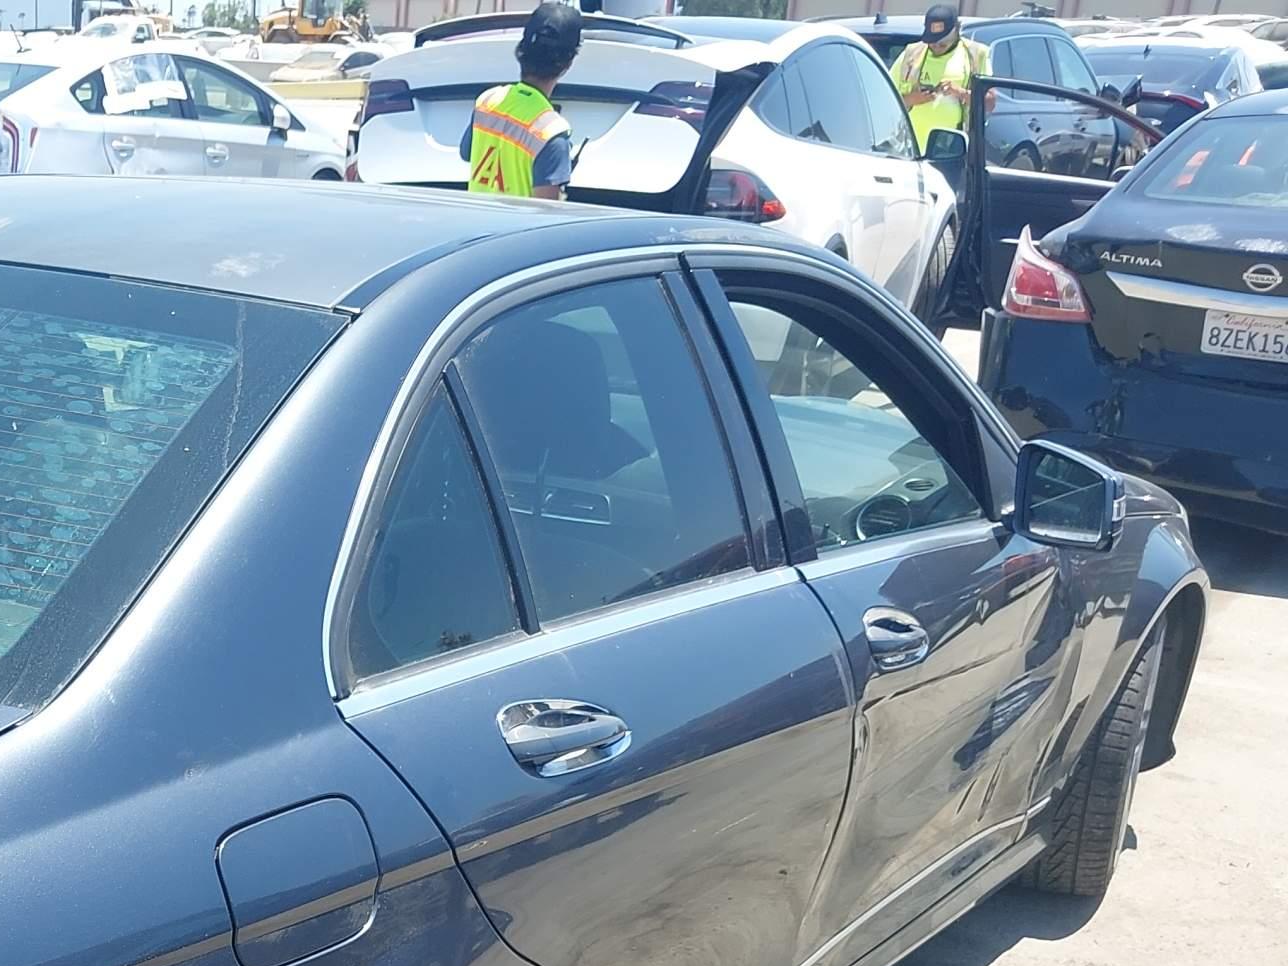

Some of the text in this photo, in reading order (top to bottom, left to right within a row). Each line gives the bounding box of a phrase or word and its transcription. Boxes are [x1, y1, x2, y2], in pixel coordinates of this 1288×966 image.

[1100, 251, 1162, 267] ALTIMA
[1224, 316, 1283, 330] California
[1208, 326, 1288, 355] 8ZEK15
